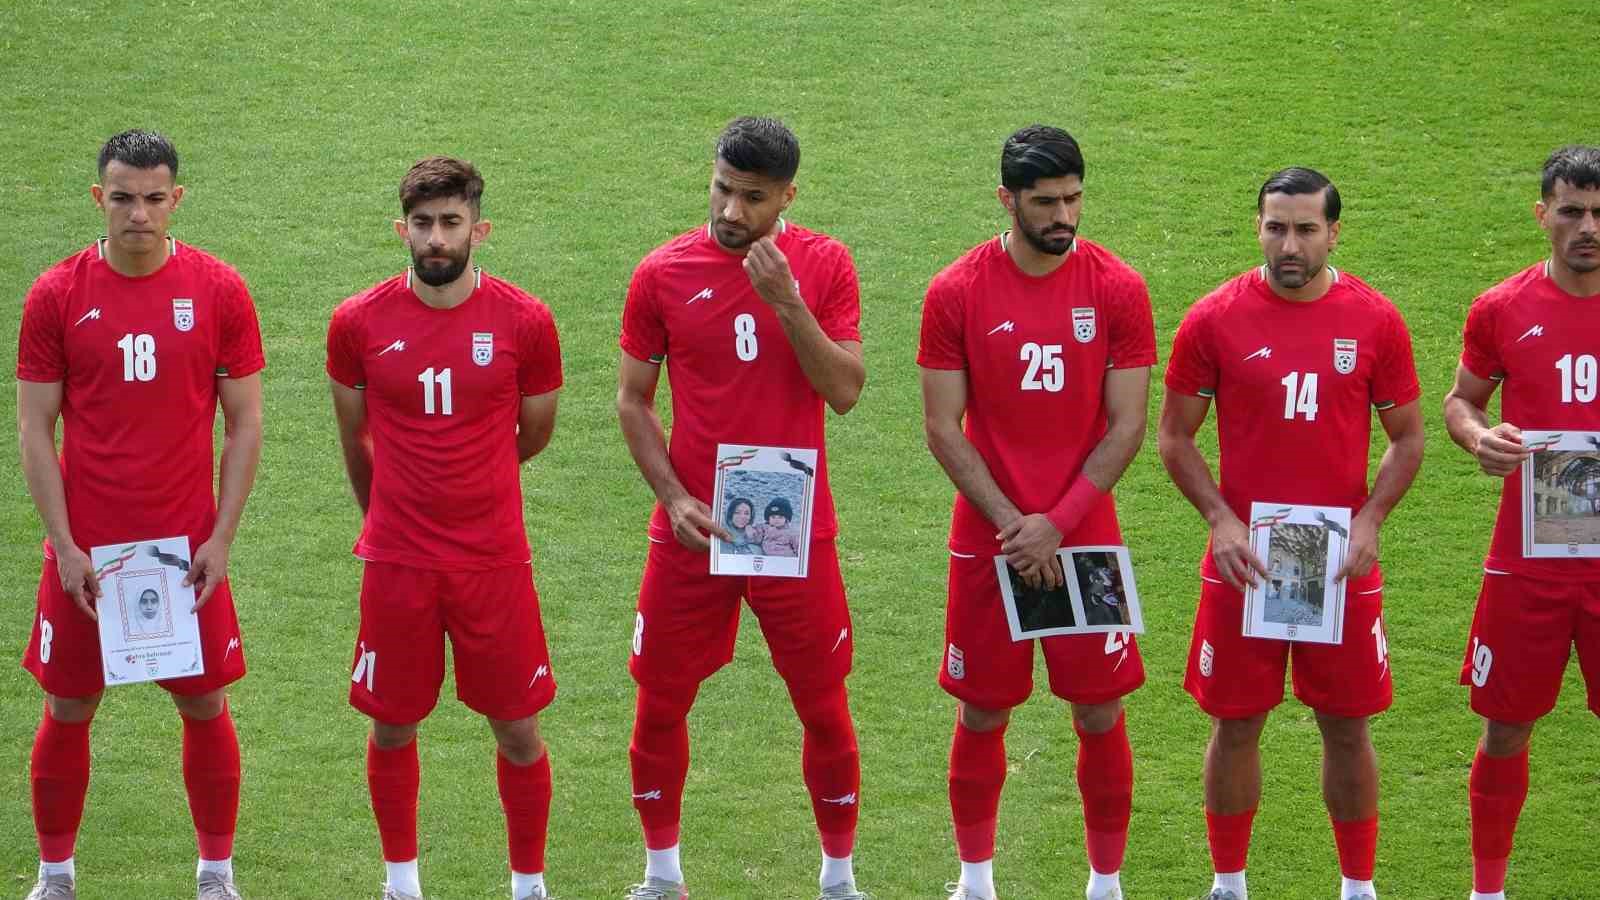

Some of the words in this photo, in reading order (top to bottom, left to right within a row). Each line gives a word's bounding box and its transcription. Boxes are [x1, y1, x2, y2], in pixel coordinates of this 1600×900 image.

[117, 333, 157, 382] 18
[734, 313, 758, 362] 8
[417, 367, 453, 416] 11
[1020, 342, 1065, 393] 25
[1555, 353, 1599, 403] 19
[1281, 371, 1319, 421] 14
[40, 611, 53, 664] 8
[632, 611, 645, 656] 8
[1104, 631, 1130, 655] 2
[1371, 616, 1388, 664] 1
